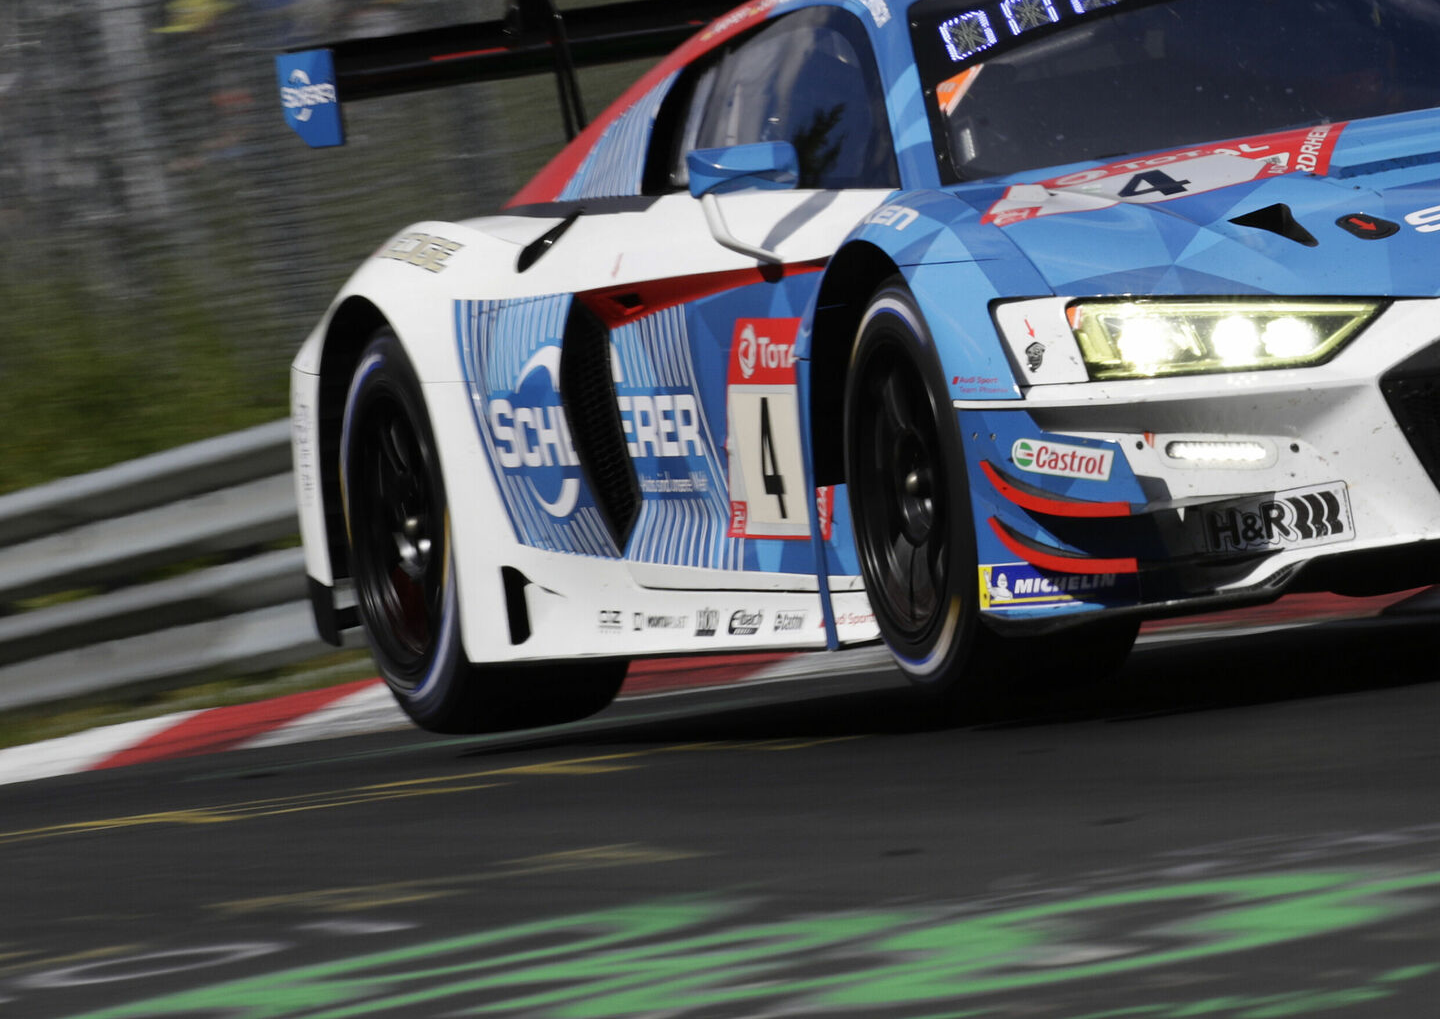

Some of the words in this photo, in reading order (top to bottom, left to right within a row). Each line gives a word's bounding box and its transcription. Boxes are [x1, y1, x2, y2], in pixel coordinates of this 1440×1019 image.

[1117, 169, 1192, 197] 4
[760, 396, 788, 519] 4
[1035, 445, 1105, 476] Castrol
[1205, 501, 1293, 551] H&R
[1014, 573, 1117, 595] MICHELIN
